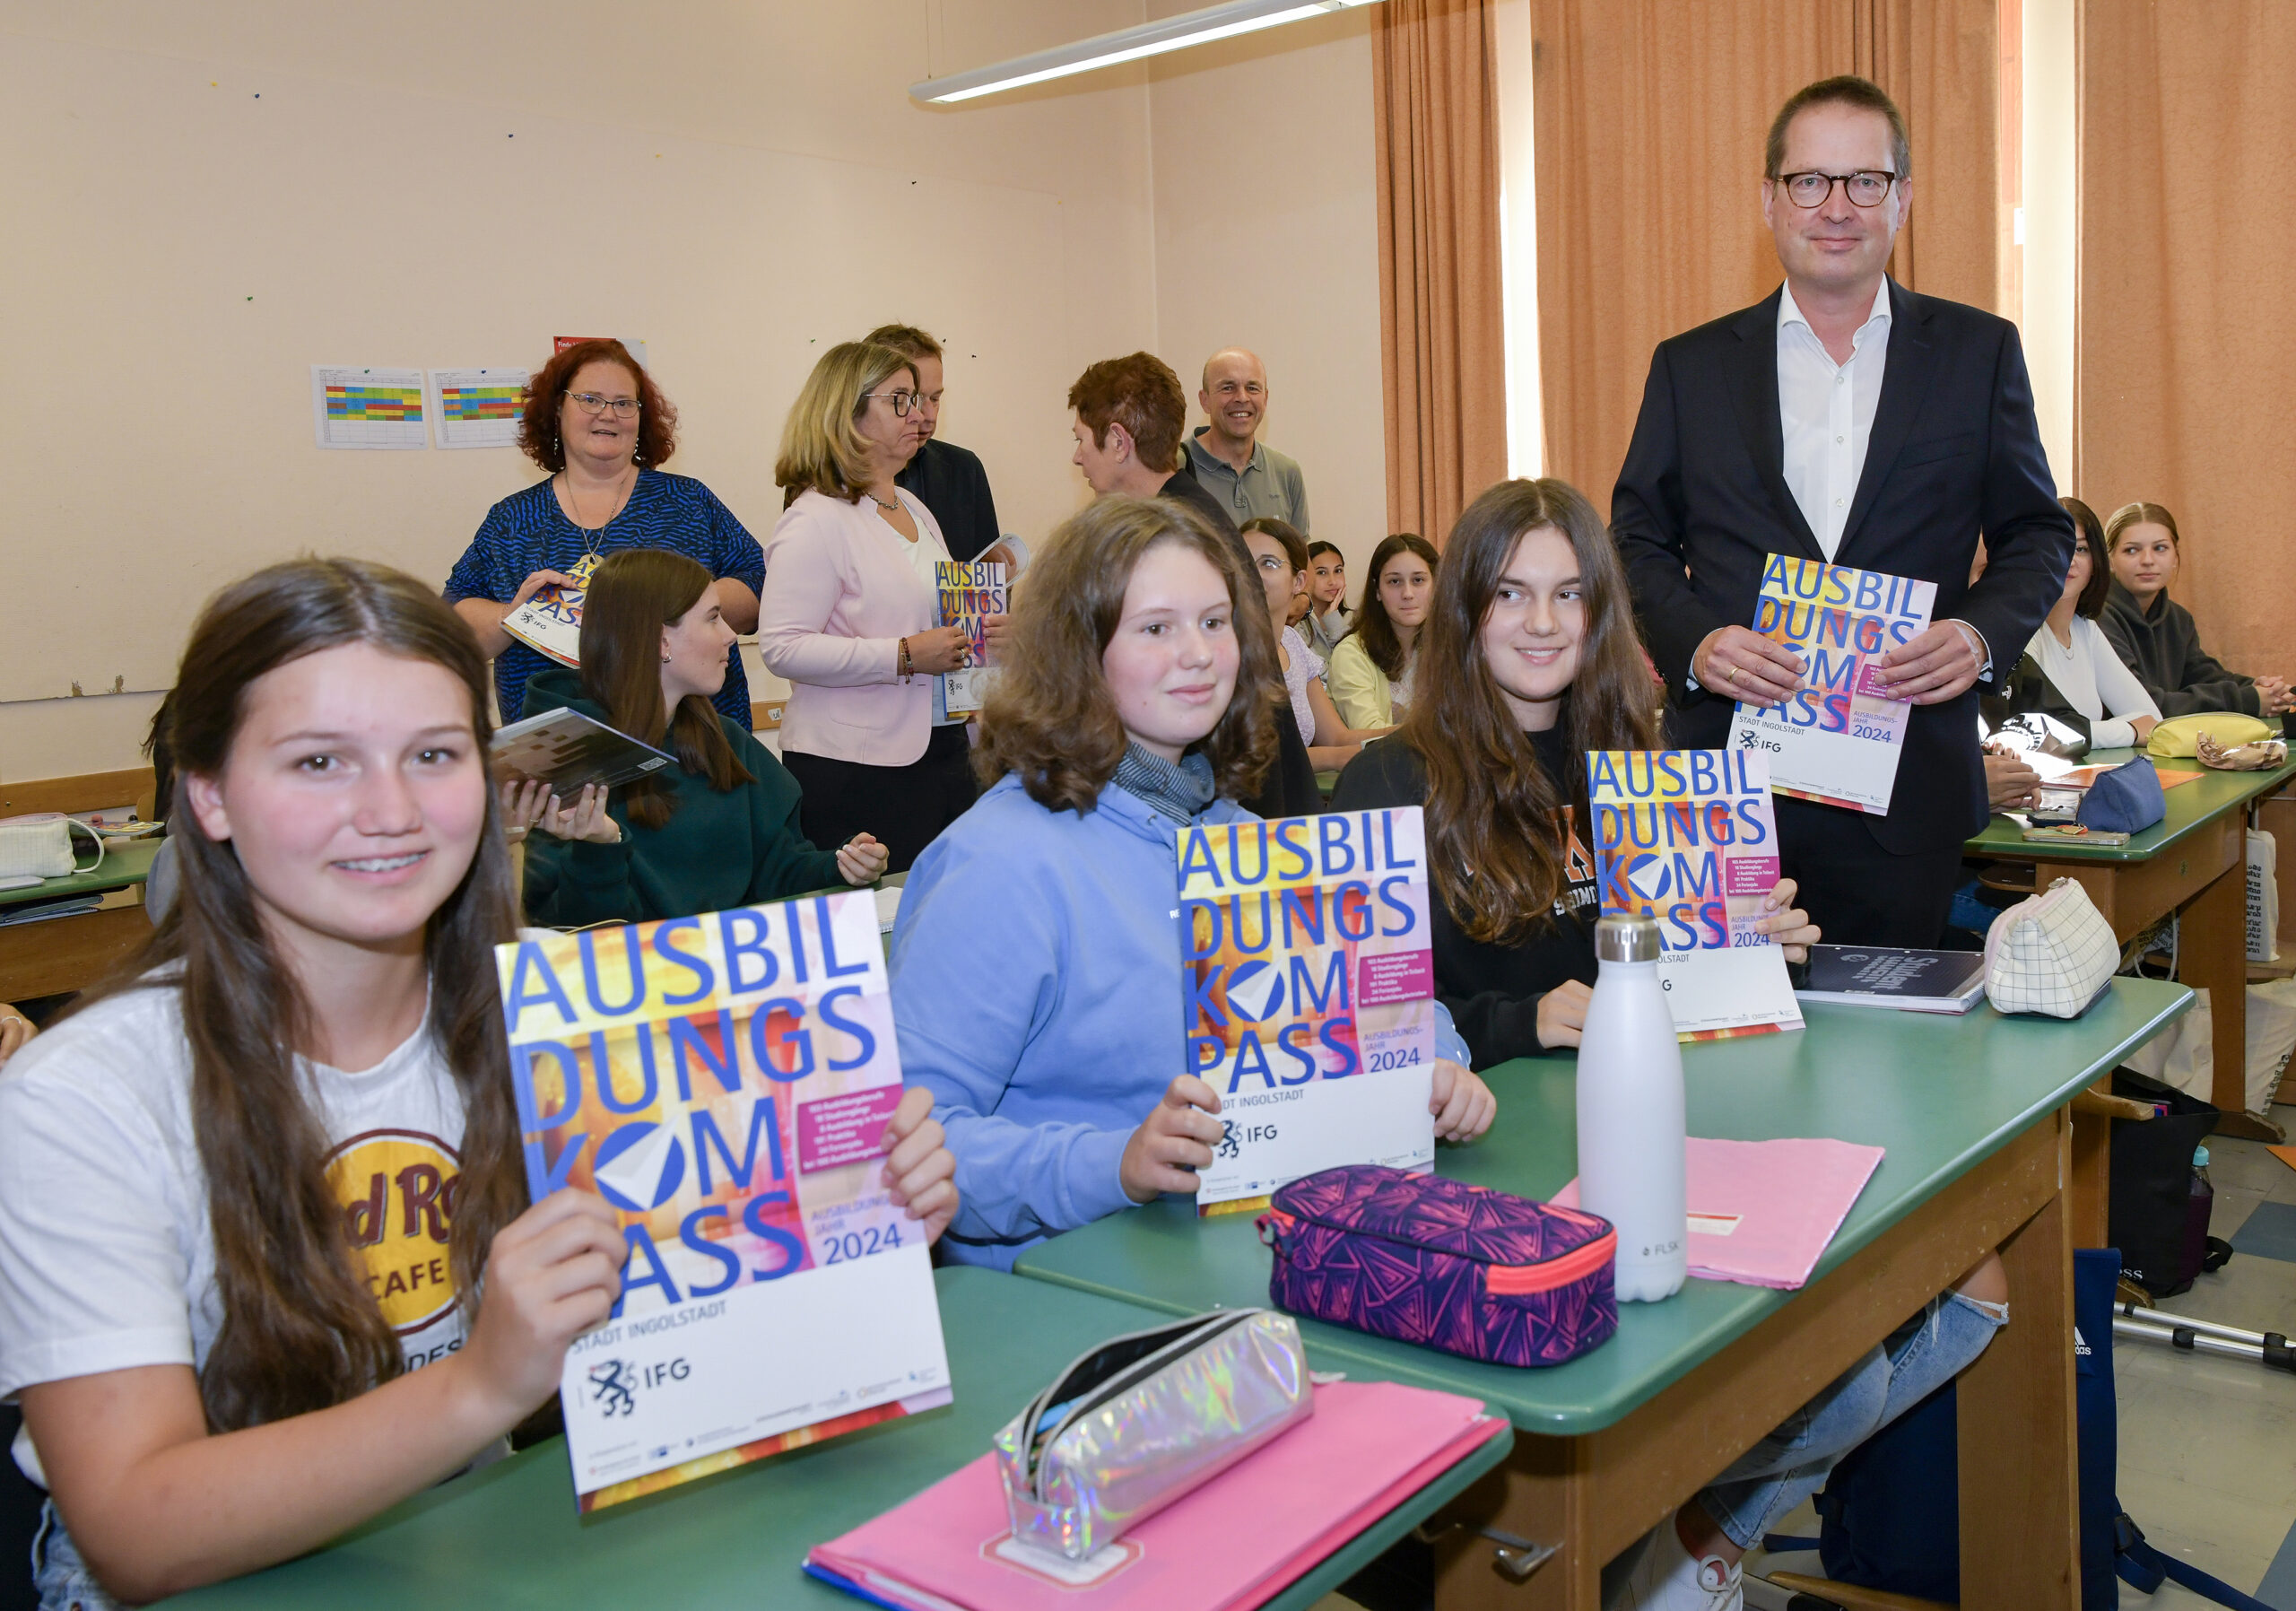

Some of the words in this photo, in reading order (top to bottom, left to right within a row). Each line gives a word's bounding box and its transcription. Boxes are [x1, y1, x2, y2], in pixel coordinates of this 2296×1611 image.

[938, 562, 1004, 587] AUSBIL
[1761, 554, 1922, 620] AUSBIL
[941, 588, 1004, 614] DUNGS
[533, 621, 547, 630] IFG
[1752, 594, 1915, 655] DUNGS
[963, 643, 986, 668] SS
[1735, 689, 1848, 732] ASS
[1738, 716, 1760, 727] STADT
[1761, 721, 1805, 736] INGOLSTADT
[1853, 710, 1898, 724] AUSBILDUNGS-
[1761, 740, 1781, 753] IFG
[1853, 725, 1892, 743] 2024
[1591, 750, 1763, 798] AUSBIL
[1593, 798, 1767, 850] DUNGS
[1178, 809, 1415, 892] AUSBIL
[1597, 850, 1720, 902] KOM
[1183, 875, 1416, 962] DUNGS
[1601, 901, 1727, 953] ASS
[1735, 931, 1770, 947] 2024
[508, 896, 870, 1034] AUSBIL
[1657, 954, 1690, 963] OLSTADT
[1187, 951, 1350, 1031] KOM
[1363, 1026, 1423, 1041] AUSBILDUNGS-
[510, 985, 876, 1134] DUNGS
[1188, 1017, 1358, 1094] PASS
[1370, 1046, 1421, 1073] 2024
[1239, 1089, 1304, 1108] INGOLSTADT
[1248, 1125, 1277, 1143] IFG
[524, 1096, 786, 1212] KOM
[812, 1194, 891, 1222] AUSBILDUNG
[609, 1191, 804, 1319] ASS
[823, 1222, 903, 1265] 2024
[571, 1326, 622, 1355] STADT
[628, 1300, 728, 1340] INGOLSTADT
[2075, 1345, 2092, 1355] das
[645, 1358, 691, 1389] IFG
